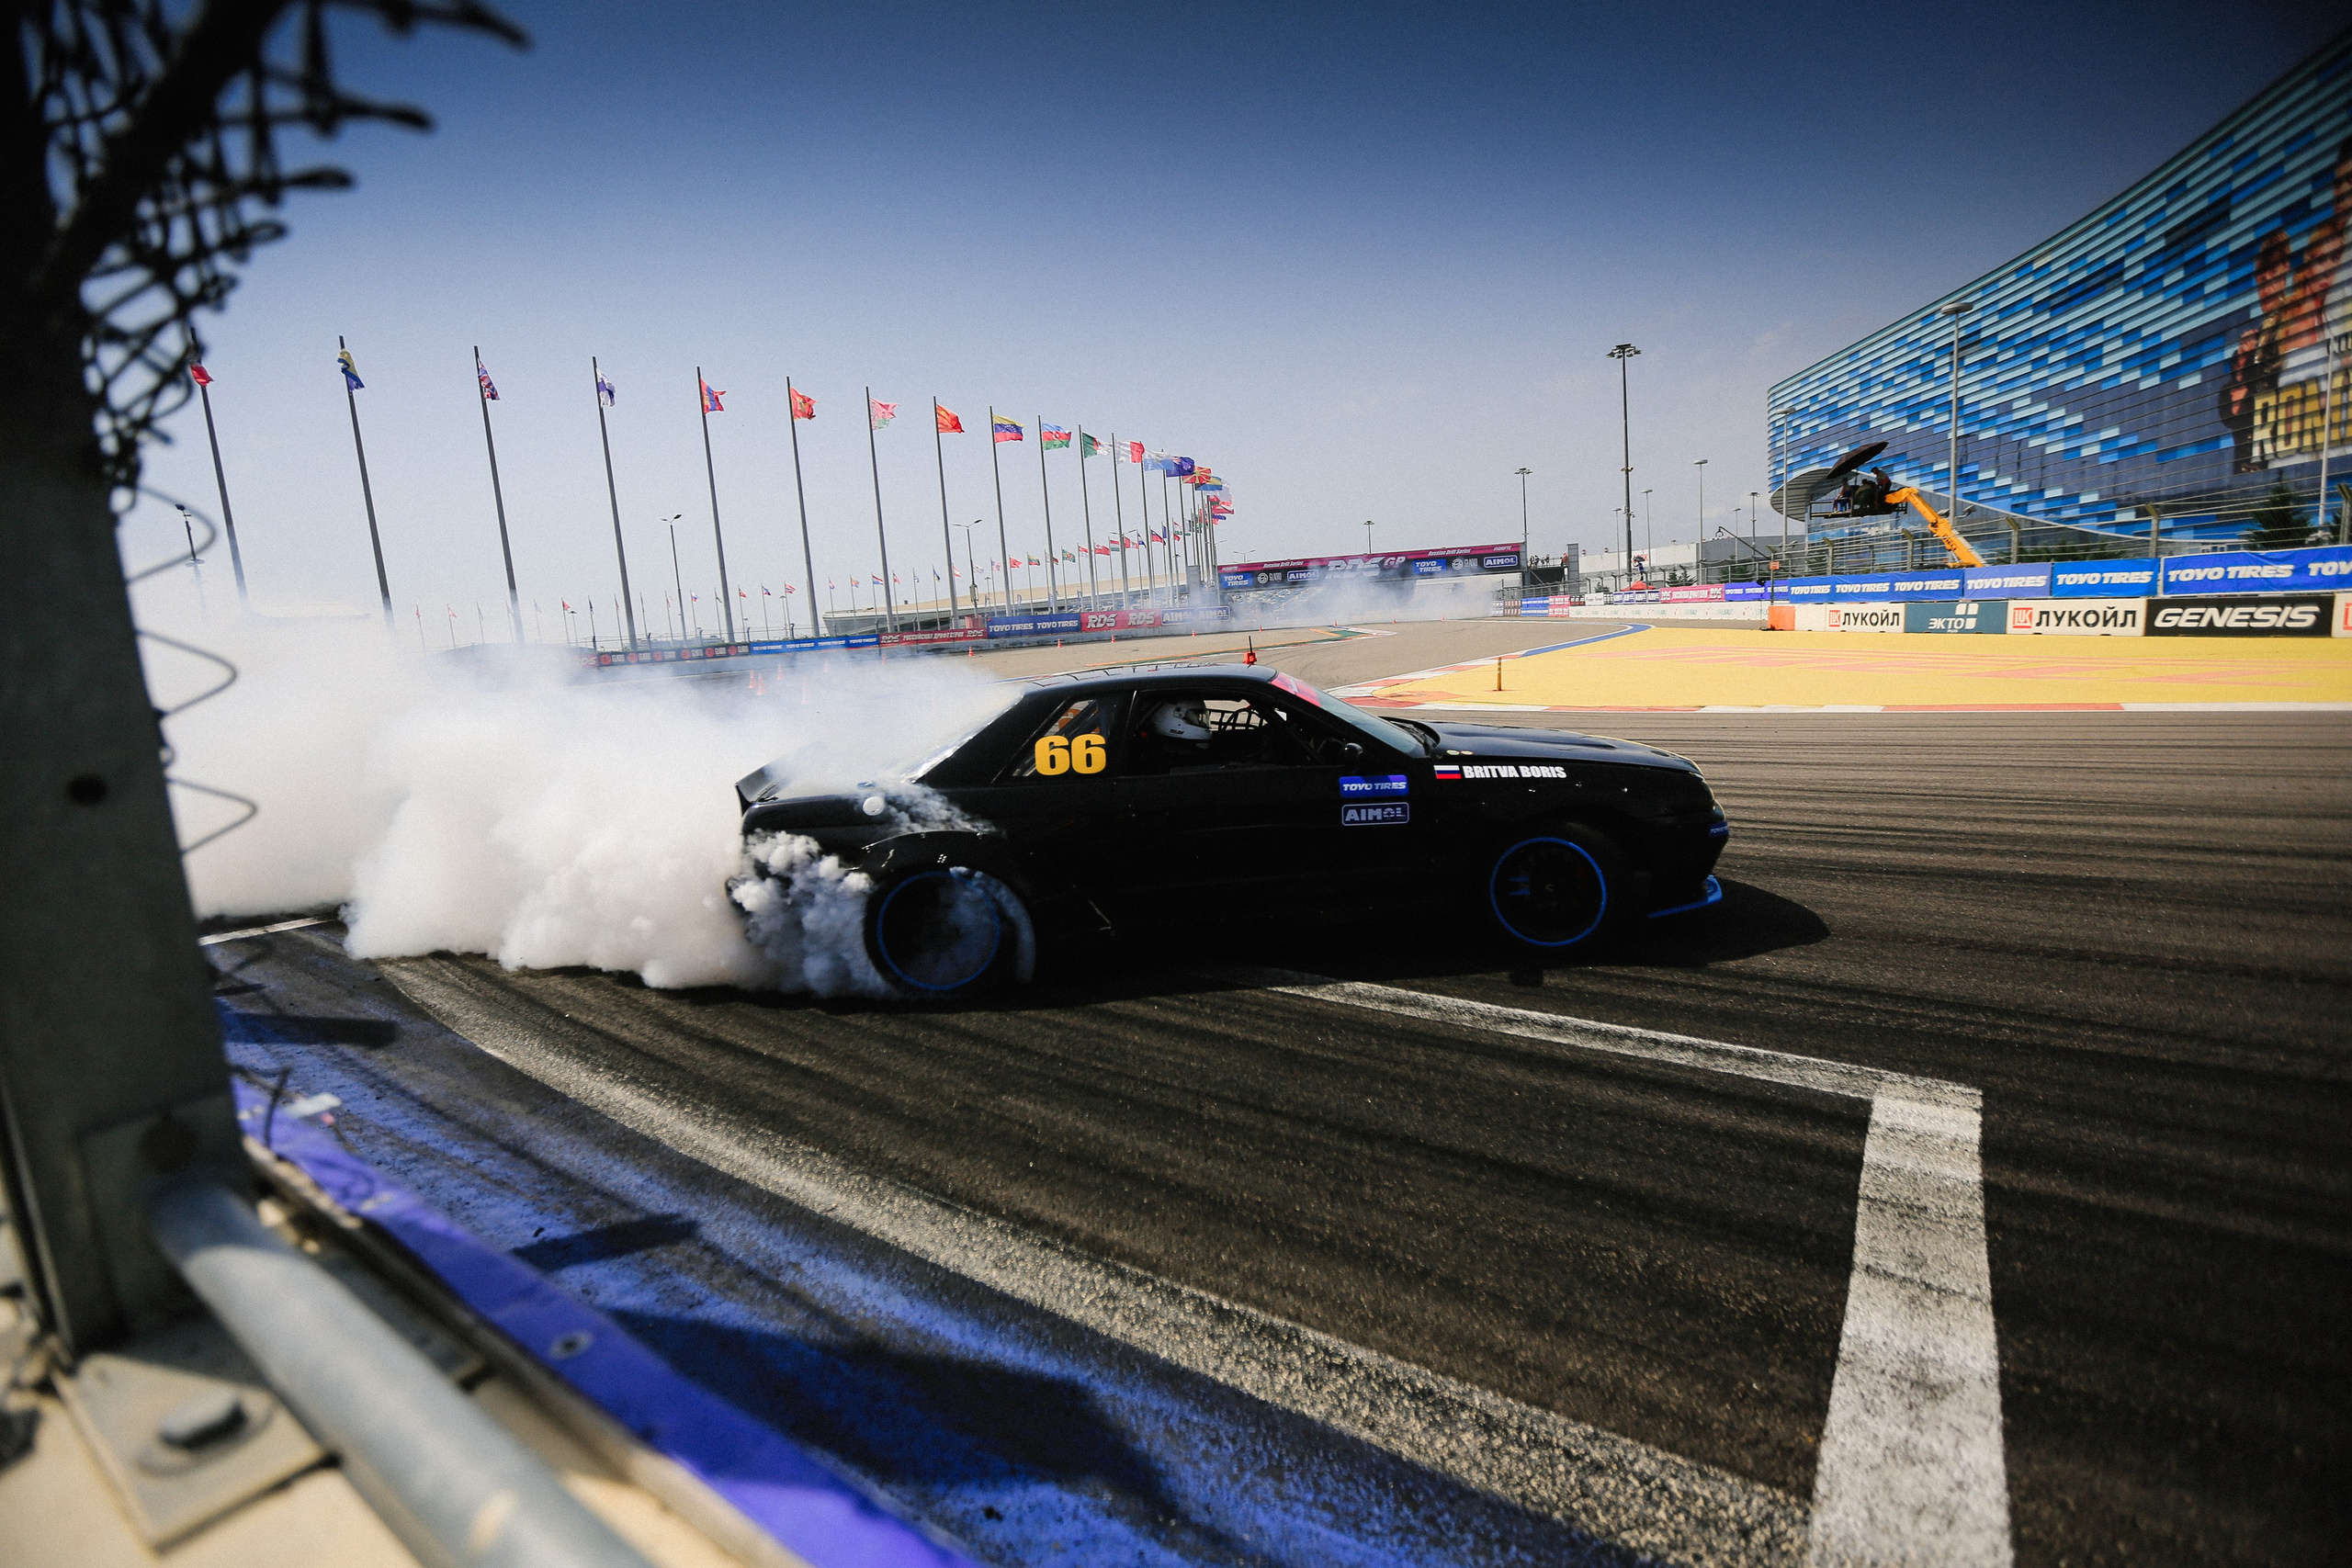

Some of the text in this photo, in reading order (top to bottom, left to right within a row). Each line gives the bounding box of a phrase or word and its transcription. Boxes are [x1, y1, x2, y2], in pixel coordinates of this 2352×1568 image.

[1384, 556, 1407, 569] GP
[1486, 557, 1516, 566] AIMOL
[1289, 571, 1317, 580] AIMOL
[2056, 570, 2154, 586] TOYO TIRES
[2167, 564, 2295, 582] TOYO TIRES
[1791, 585, 1811, 595] TOYO
[1811, 584, 1831, 594] TIRES
[1836, 581, 1890, 593] TOYO TIRES
[1894, 579, 1961, 592] TOYO TIRES
[1966, 575, 2048, 590] TOYO TIRES
[1087, 613, 1118, 628] RDS
[1127, 611, 1156, 626] RDS
[1842, 609, 1900, 626] ЛУКОЙЛ
[1928, 617, 1965, 629] ЭКТО
[2035, 606, 2137, 627] ЛУКОЙЛ
[2154, 605, 2321, 628] GENESIS
[1012, 623, 1034, 631] TIRES
[1037, 621, 1057, 629] TOYO
[1035, 734, 1107, 776] 66
[1462, 765, 1567, 779] BRITVA BORIS
[1342, 782, 1407, 792] TOYO TIRES
[1344, 807, 1407, 821] AIMOL
